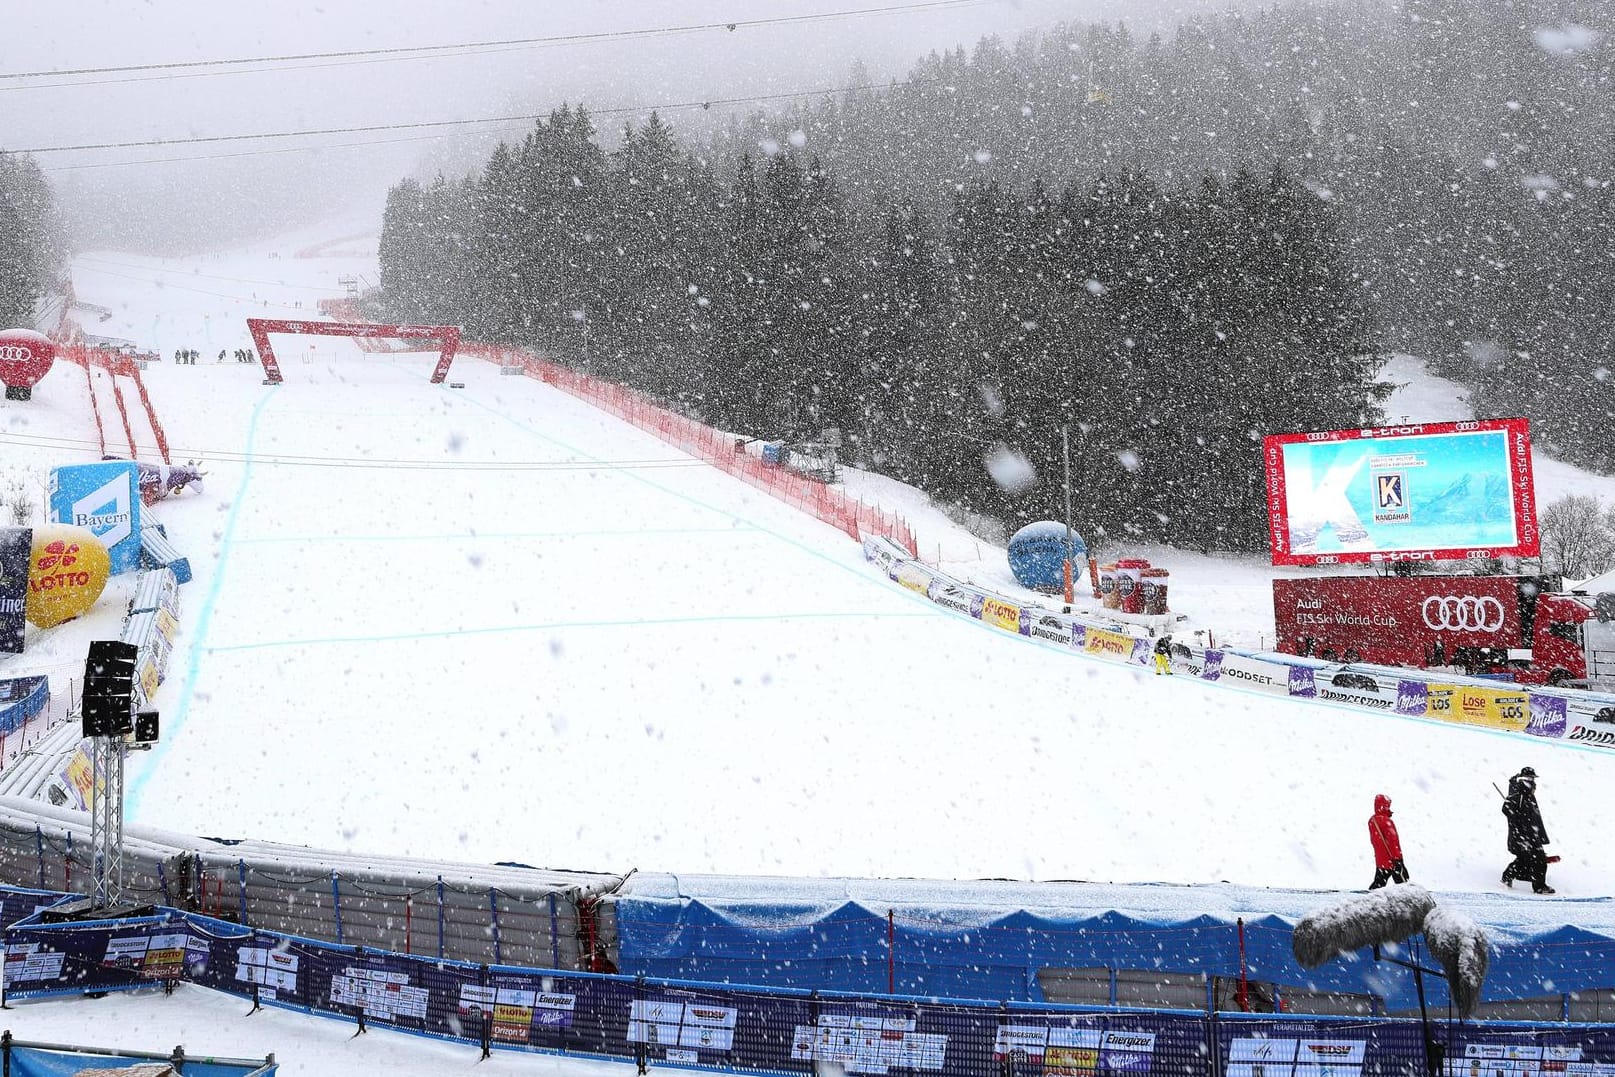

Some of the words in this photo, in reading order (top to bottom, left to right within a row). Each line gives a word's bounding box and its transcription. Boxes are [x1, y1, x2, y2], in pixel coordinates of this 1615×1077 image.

[1360, 426, 1423, 437] e-tron
[1516, 432, 1526, 458] Audi
[1270, 448, 1278, 466] Cup
[1519, 459, 1528, 474] FIS
[1271, 468, 1279, 496] World
[1520, 475, 1529, 490] Ski
[1272, 497, 1280, 511] Ski
[1521, 491, 1531, 522] World
[76, 511, 129, 528] Bayern
[1273, 513, 1281, 528] FIS
[1375, 513, 1410, 521] KANDAHAR
[1524, 523, 1532, 543] Cup
[1274, 530, 1282, 552] Audi
[1370, 551, 1434, 561] e-tron
[29, 571, 90, 592] LOTTO
[1296, 599, 1322, 609] Audi
[1296, 613, 1315, 624] FIS
[1316, 613, 1333, 625] Ski
[1334, 612, 1371, 625] World
[1373, 614, 1397, 627] Cup
[1288, 677, 1315, 693] Milka
[1320, 688, 1394, 709] BRIDGESTONE
[1399, 694, 1427, 711] Milka
[1432, 698, 1450, 711] LOS
[1462, 693, 1486, 708] Lose
[1502, 706, 1523, 719] LOS
[1530, 713, 1565, 729] Milka
[158, 951, 180, 959] LOTTO
[539, 994, 573, 1005] Energizer
[507, 1008, 528, 1017] LOTTO
[540, 1011, 565, 1024] Milka
[494, 1025, 518, 1036] Orizon
[1000, 1030, 1044, 1040] BRIDGESTONE
[1105, 1033, 1151, 1047] Energizer
[1107, 1054, 1140, 1069] Milka
